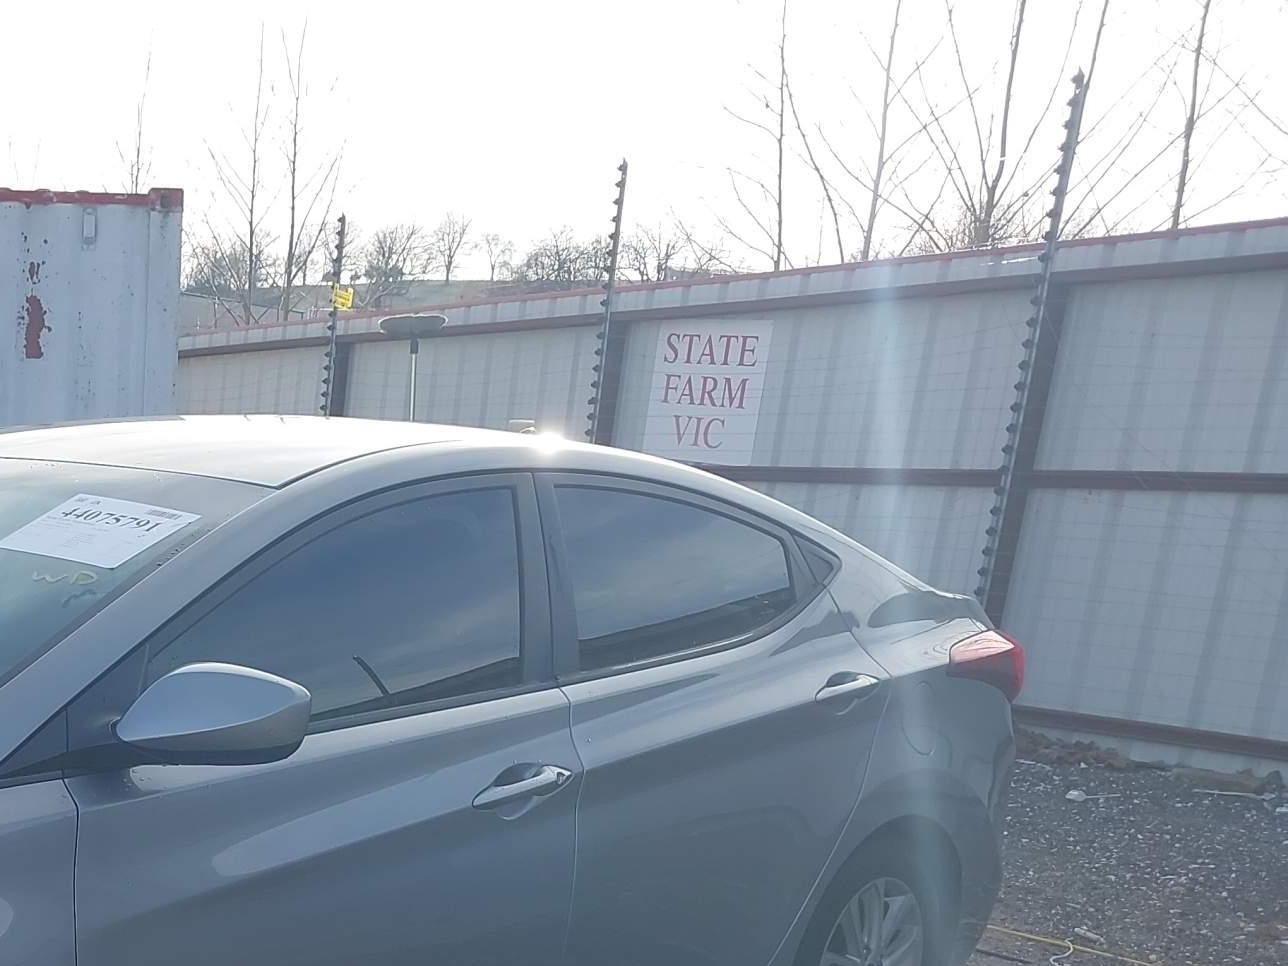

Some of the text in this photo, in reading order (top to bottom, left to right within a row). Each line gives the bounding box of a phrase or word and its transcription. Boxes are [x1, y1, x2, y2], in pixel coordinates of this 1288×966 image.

[663, 332, 759, 367] STATE
[661, 373, 750, 409] FARM
[672, 414, 726, 449] VIC
[61, 507, 162, 532] 44075791
